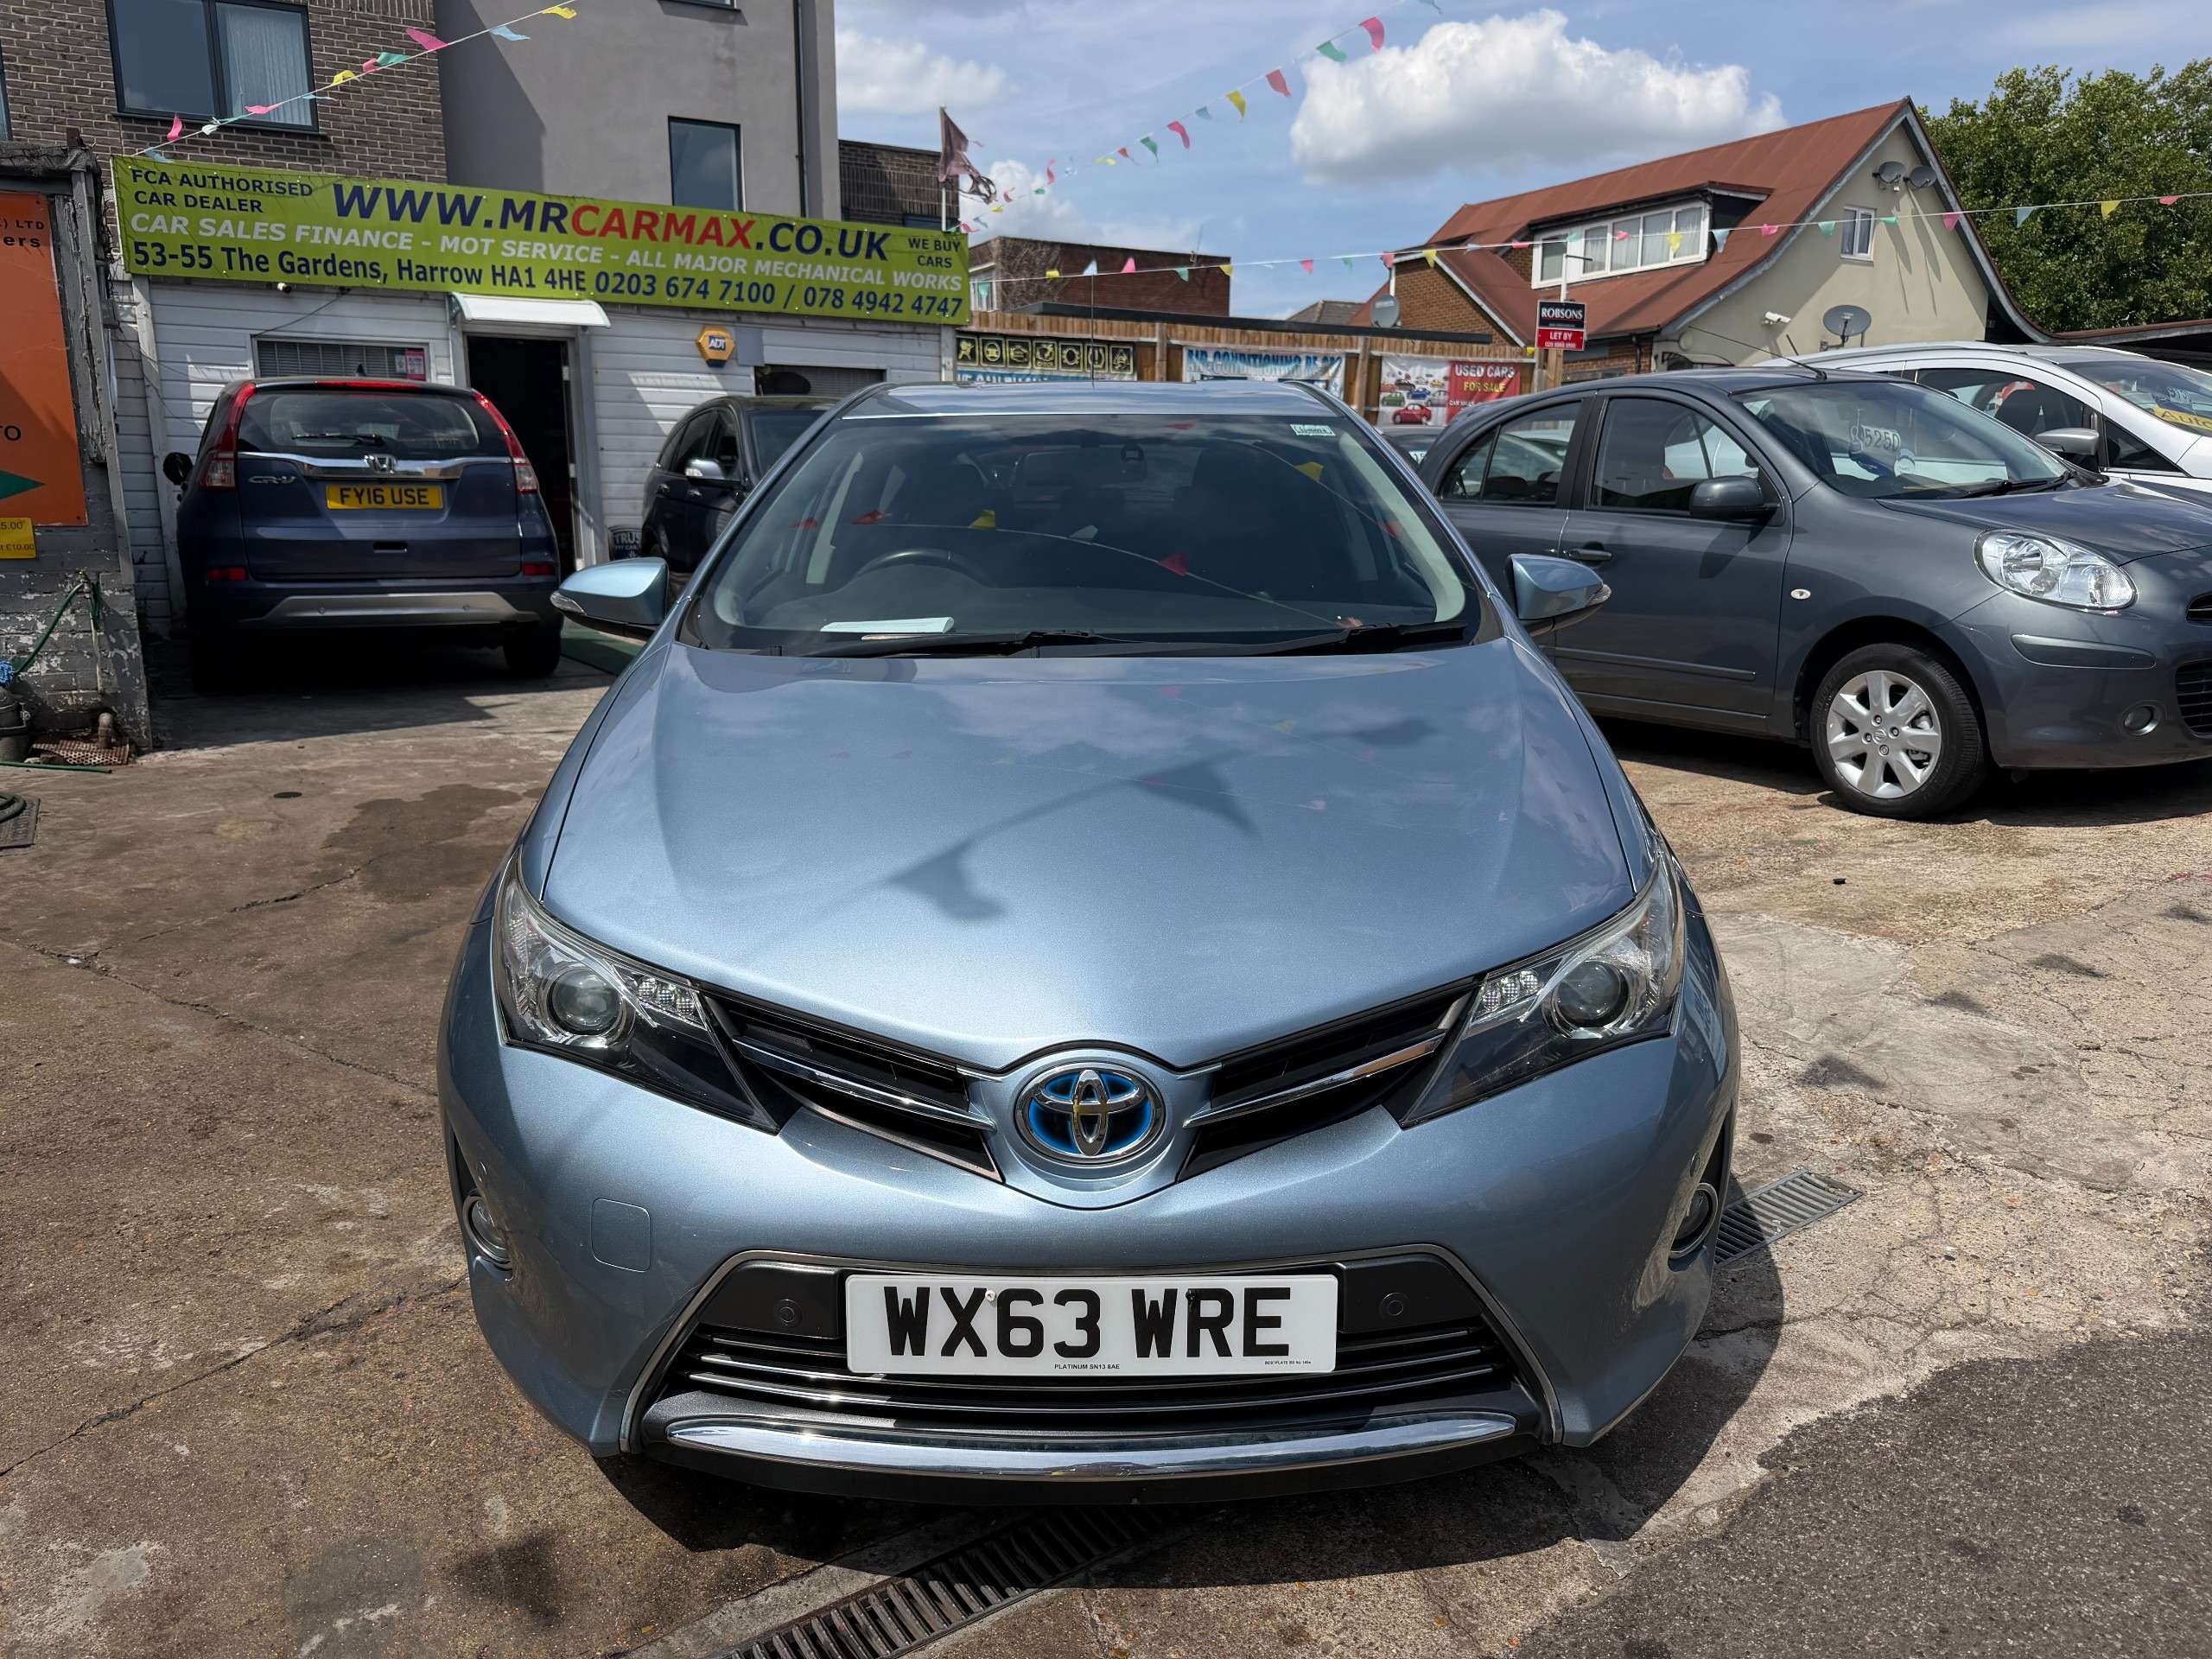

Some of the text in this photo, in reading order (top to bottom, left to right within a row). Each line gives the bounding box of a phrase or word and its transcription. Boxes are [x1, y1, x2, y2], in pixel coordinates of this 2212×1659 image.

[131, 169, 313, 197] FCA AUTHORISED
[134, 191, 264, 213] CAR DEALER
[16, 219, 45, 230] LTD
[333, 183, 892, 261] WWW.MRCARMAX.CO.UK
[130, 213, 189, 235] CAR
[199, 218, 286, 241] SALES
[296, 225, 414, 251] FINANCE
[440, 235, 495, 256] MOT
[501, 240, 604, 264] SERVICE
[626, 250, 667, 269] ALL
[674, 252, 747, 274] MAJOR
[753, 260, 886, 285] MECHANICAL
[893, 270, 963, 291] WORKS
[908, 238, 961, 252] WE BUY
[918, 255, 952, 269] CARS
[133, 241, 213, 270] 53-55
[220, 246, 270, 272] The
[277, 251, 388, 284] Gardens,
[397, 258, 483, 285] Harrow
[491, 264, 536, 289] HA1
[544, 269, 587, 291] 4HE
[595, 270, 658, 296] 0203
[665, 276, 710, 300] 674
[719, 279, 775, 304] 7100
[804, 286, 844, 309] 078
[852, 290, 904, 314] 4942
[911, 296, 963, 317] 4747
[1541, 307, 1583, 320] ROBSONS
[1549, 331, 1573, 340] LET BY
[709, 338, 725, 349] ADT
[1455, 364, 1515, 378] USED CARS
[1464, 381, 1507, 393] FOR SALE
[340, 487, 429, 505] FY16 USE
[884, 1286, 1292, 1359] WX63 WRE
